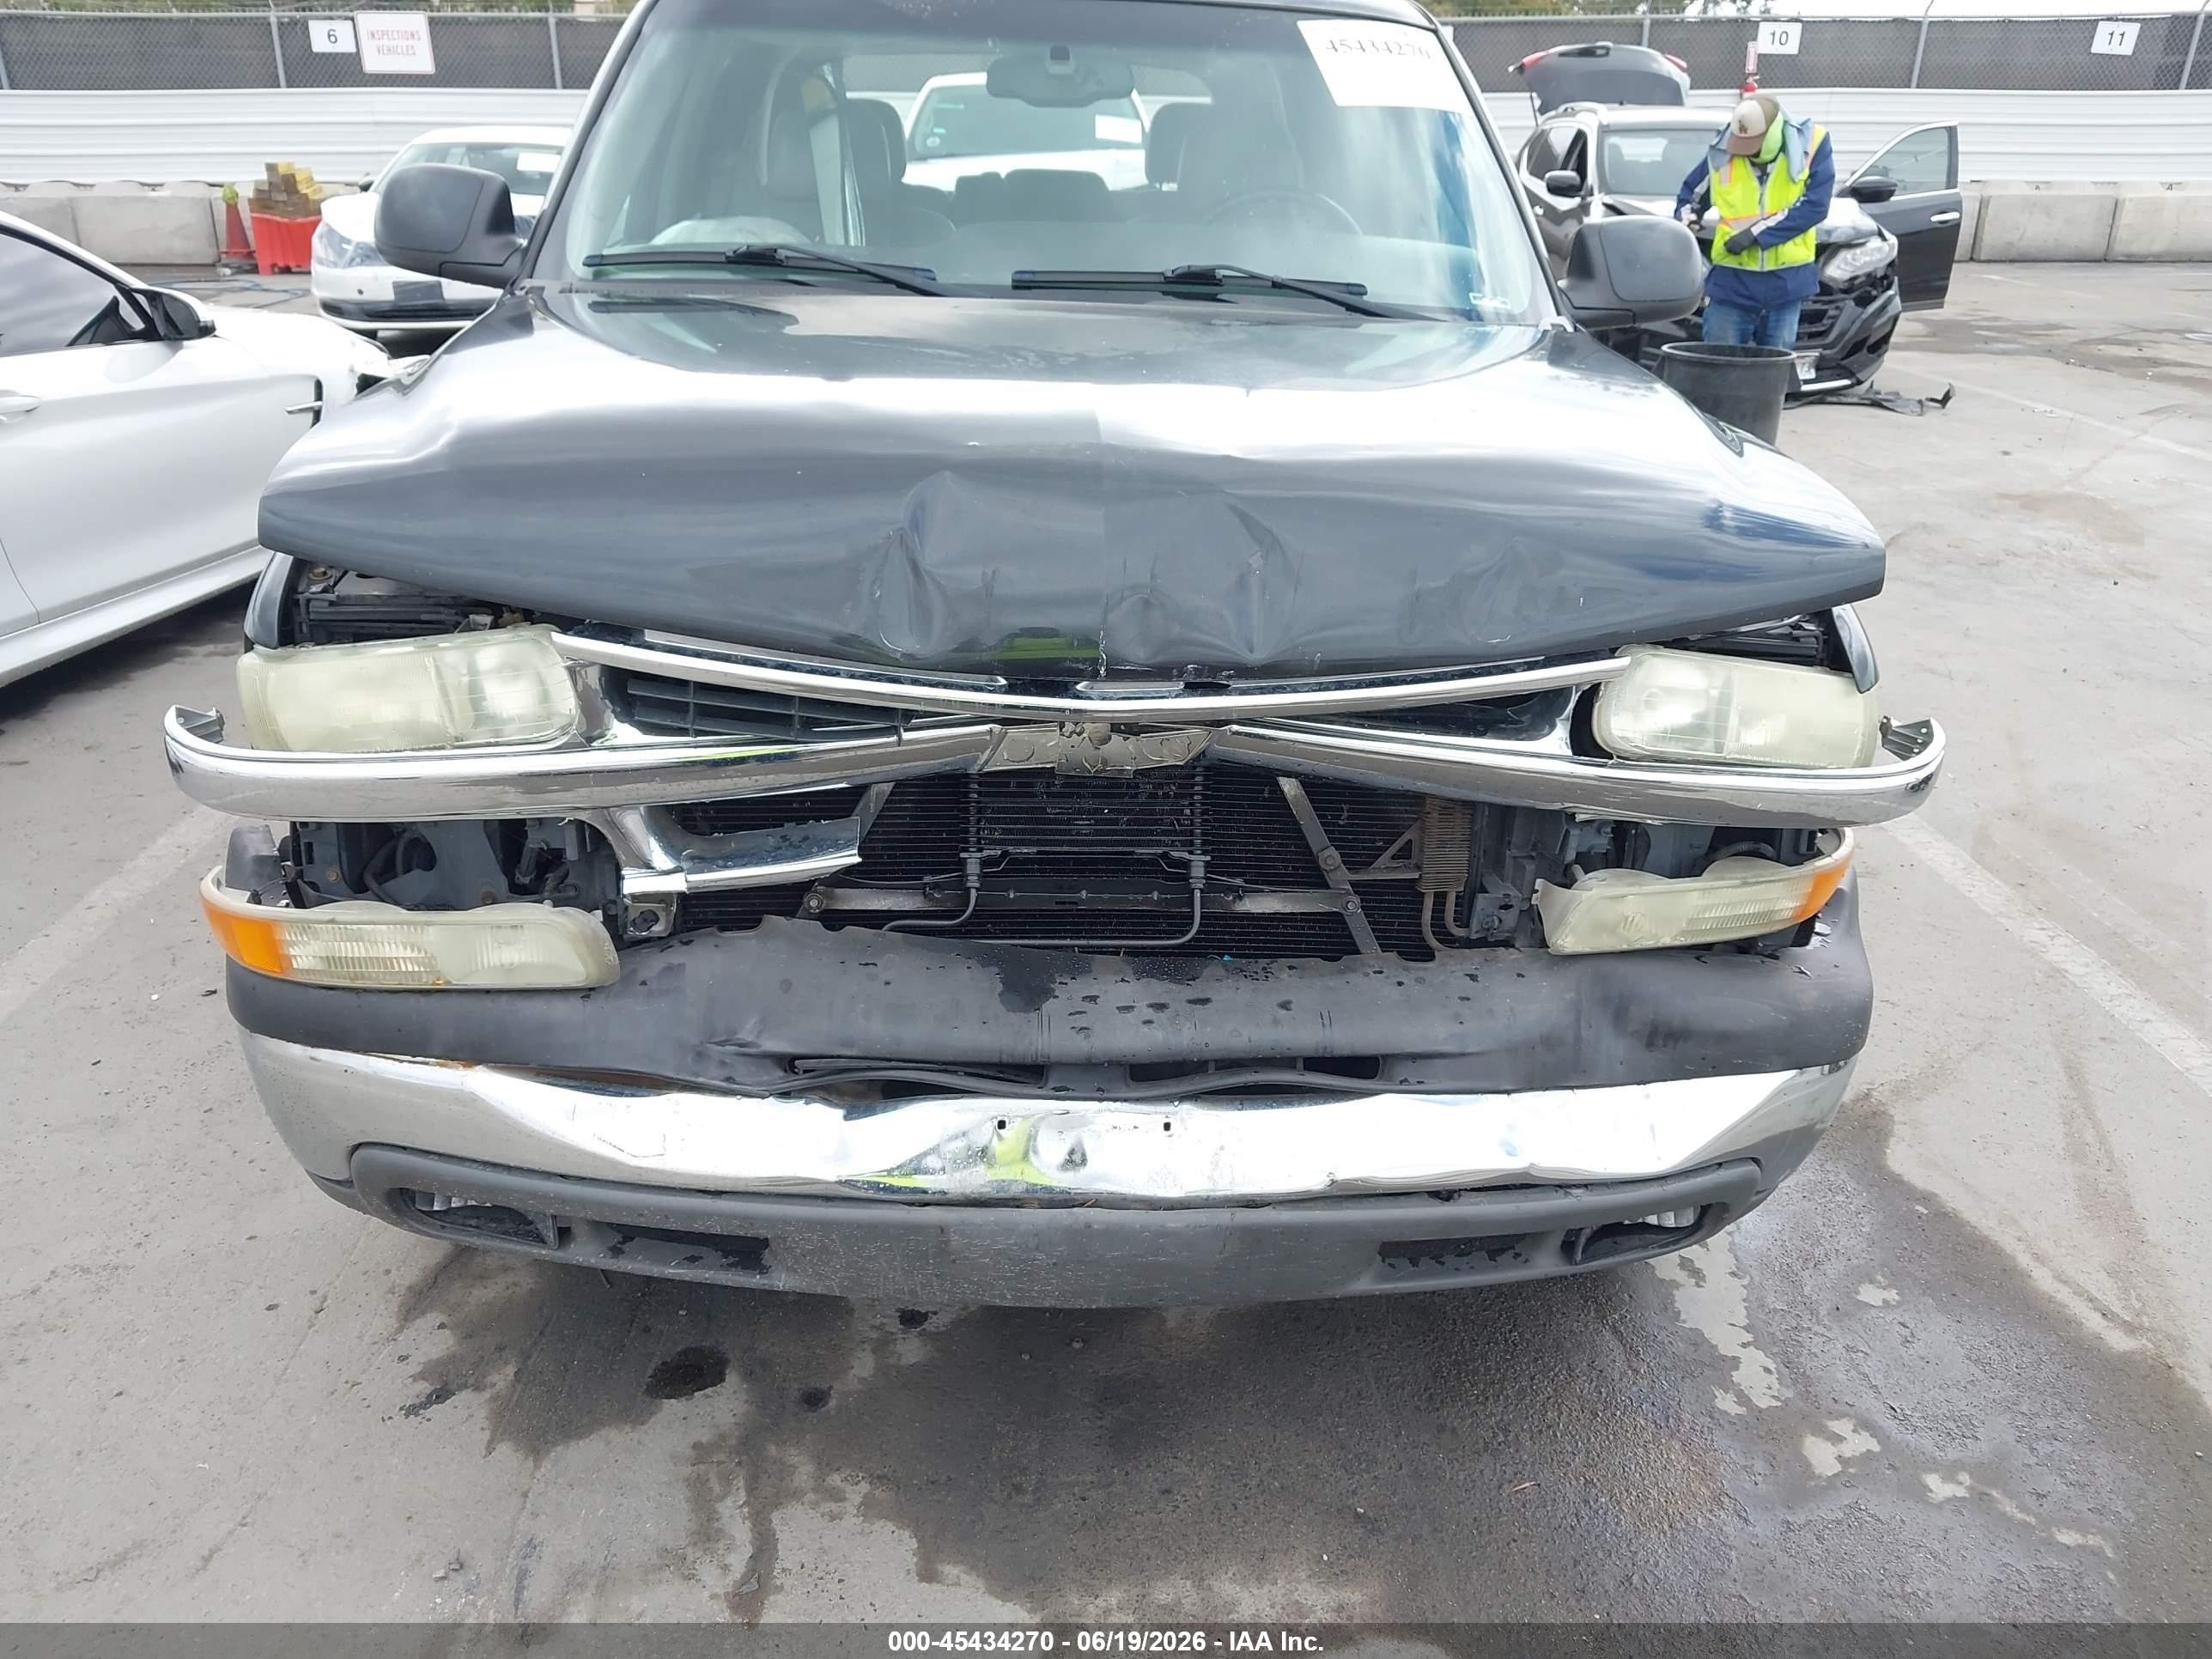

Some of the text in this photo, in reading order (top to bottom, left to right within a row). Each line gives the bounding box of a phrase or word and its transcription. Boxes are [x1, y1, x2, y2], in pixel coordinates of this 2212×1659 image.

[326, 28, 338, 44] 6
[367, 29, 421, 41] INSPECTIONS
[1769, 30, 1790, 46] 10
[2108, 30, 2125, 46] 11
[376, 45, 416, 55] VEHICLES
